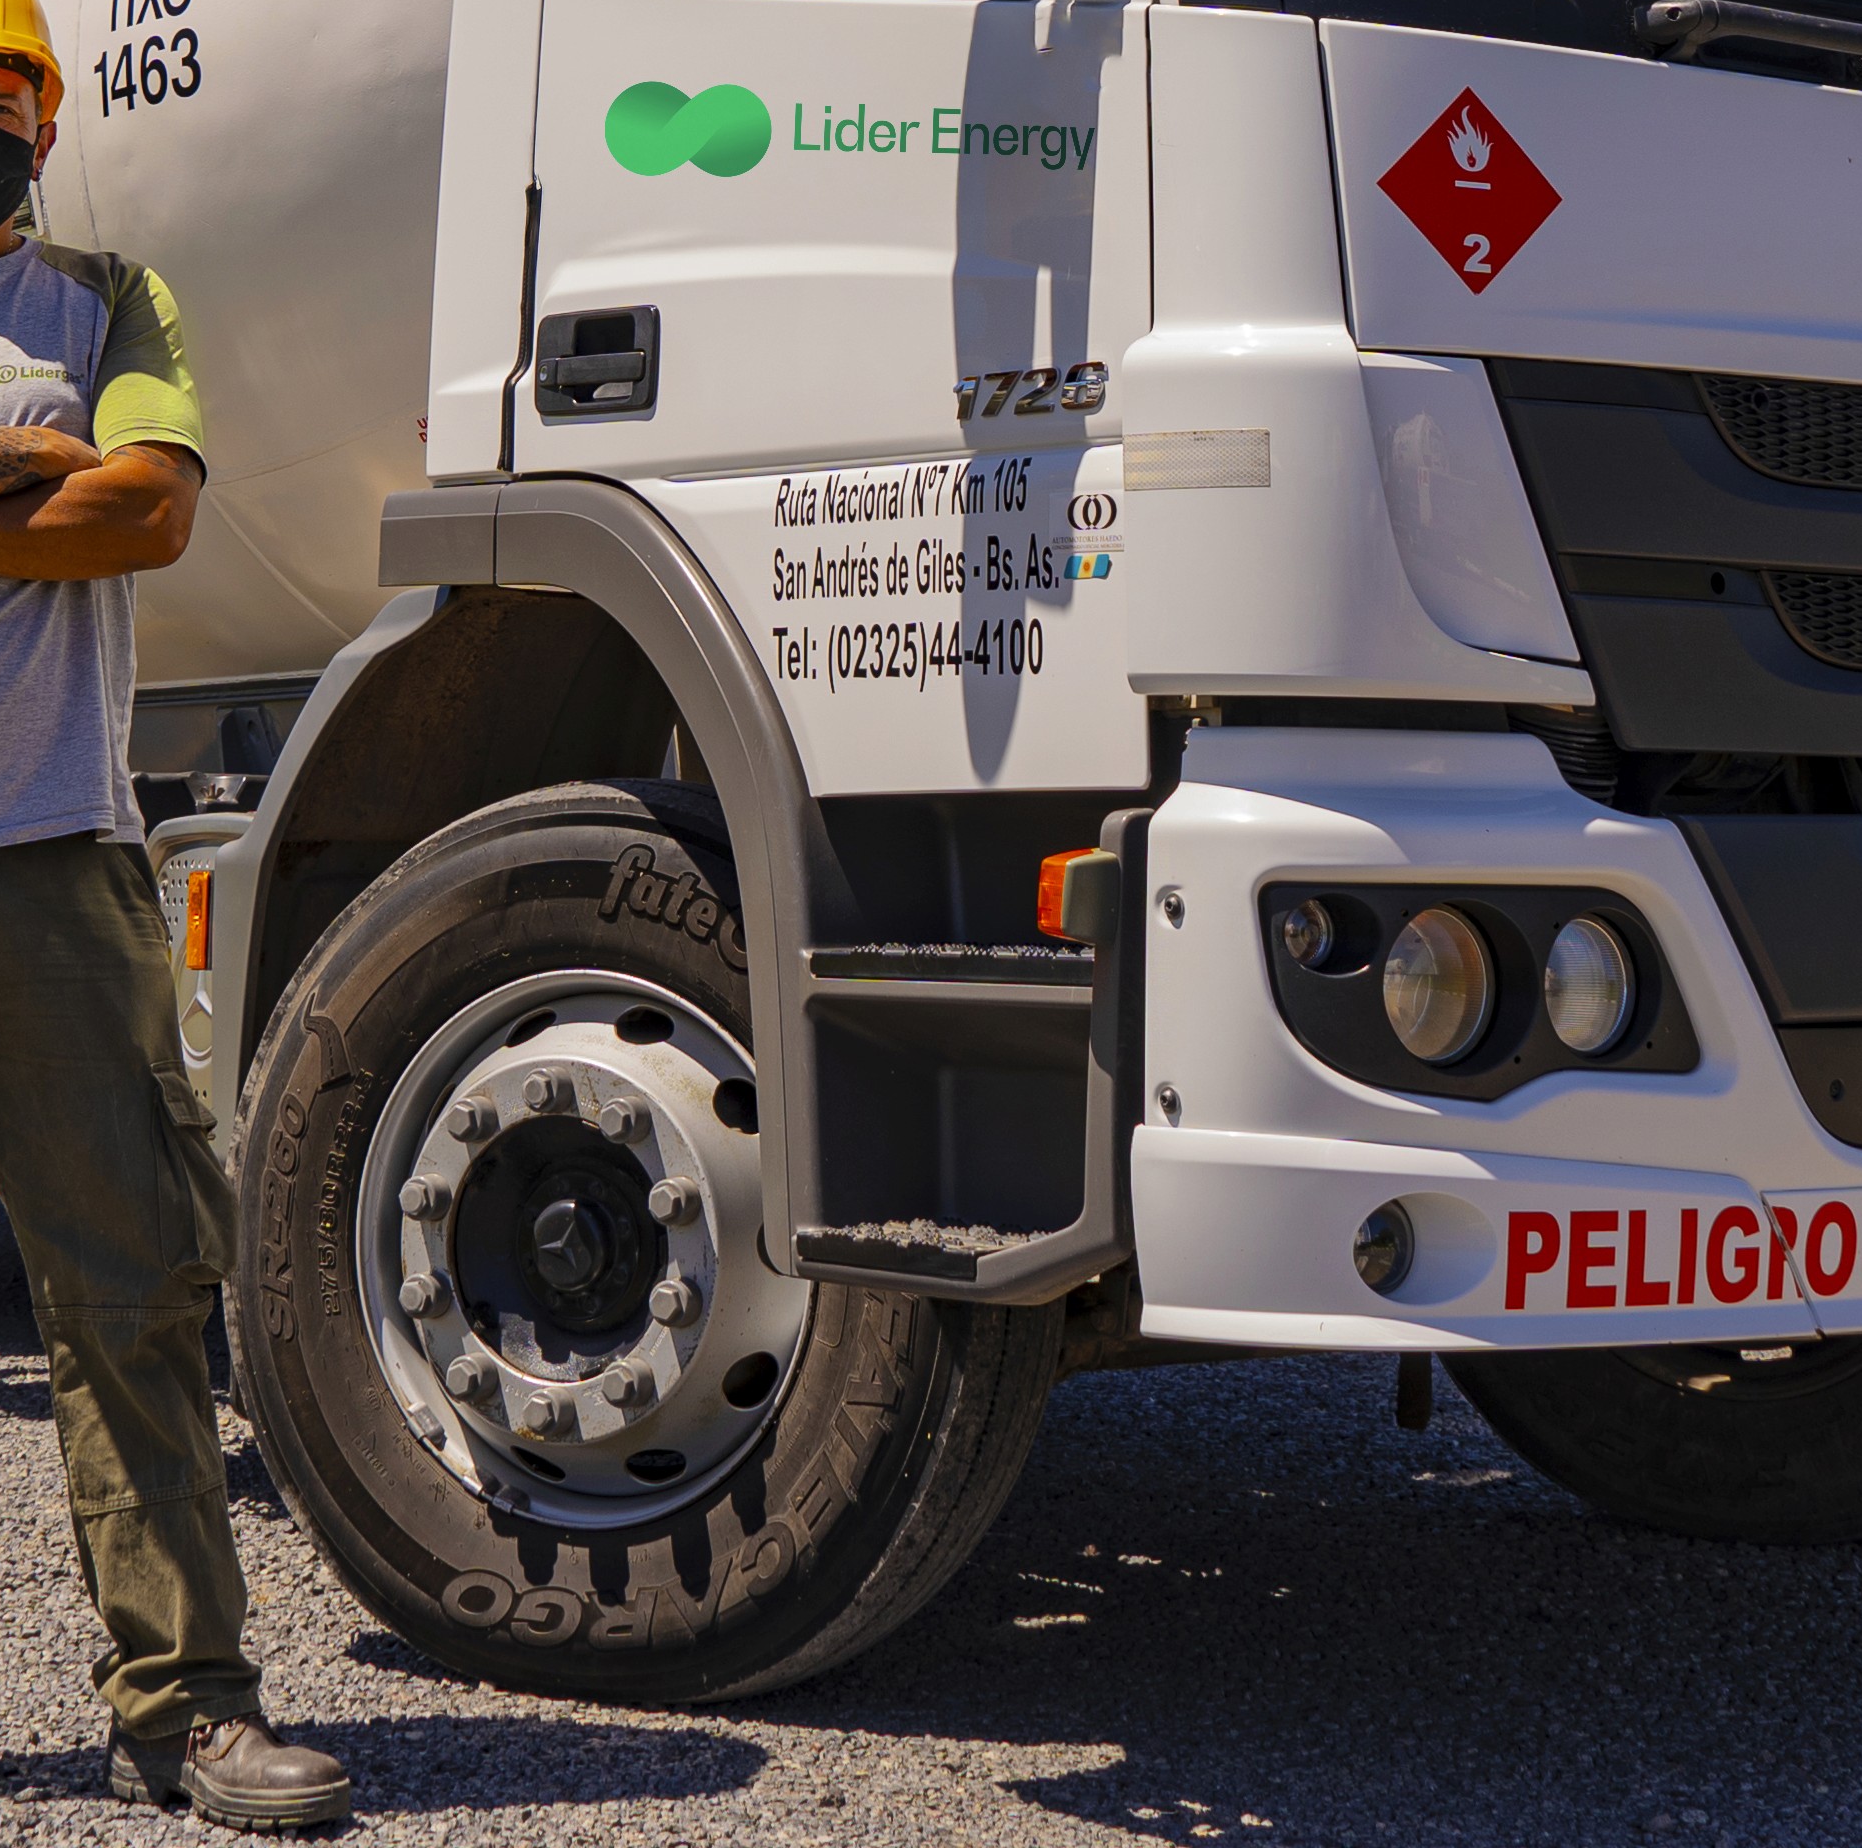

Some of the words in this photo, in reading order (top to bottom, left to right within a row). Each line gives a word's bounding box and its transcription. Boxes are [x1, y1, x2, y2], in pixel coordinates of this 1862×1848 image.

[94, 28, 202, 118] 1463
[793, 103, 920, 153] Lider
[931, 107, 1096, 170] Energy
[1463, 233, 1492, 274] 2
[953, 361, 1109, 428] 1726
[775, 478, 817, 528] Ruta
[951, 461, 985, 515] Km
[994, 457, 1033, 513] 105
[773, 548, 806, 601] San
[812, 542, 879, 598] Andrés
[887, 542, 909, 597] de
[916, 539, 966, 594] Giles
[987, 535, 1019, 591] Bs.
[1025, 533, 1060, 589] As.
[773, 627, 817, 680] Tel:
[828, 618, 1043, 694] (02325)44-4100
[260, 1092, 307, 1343] SR-260
[1504, 1200, 1857, 1310] PELIGRO
